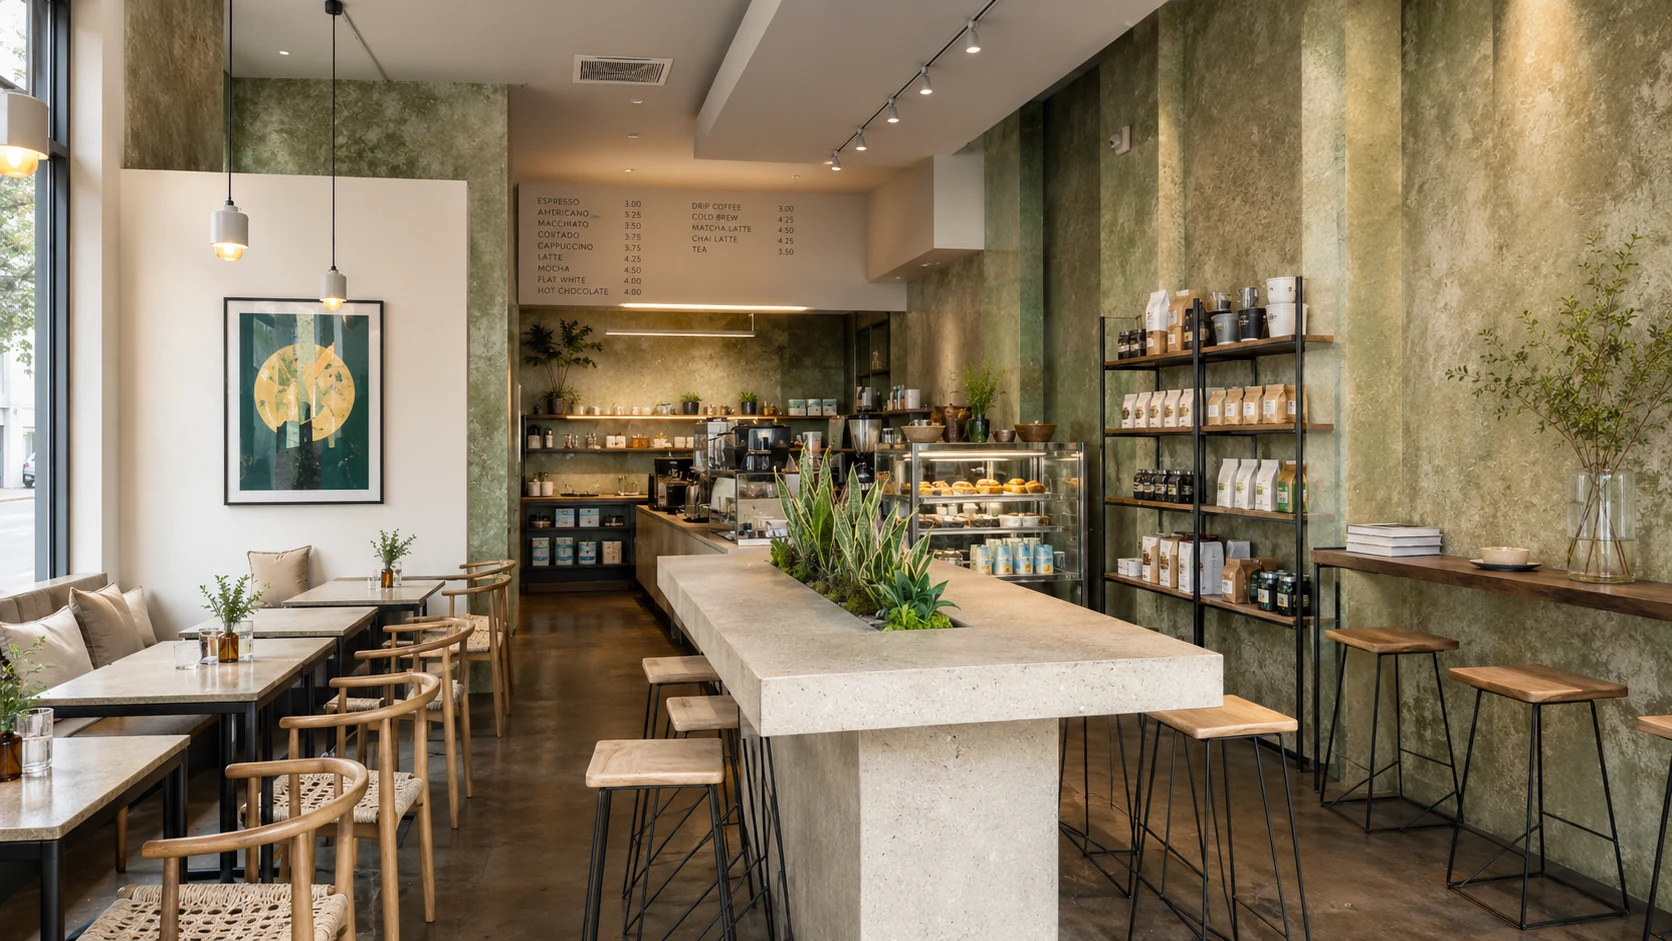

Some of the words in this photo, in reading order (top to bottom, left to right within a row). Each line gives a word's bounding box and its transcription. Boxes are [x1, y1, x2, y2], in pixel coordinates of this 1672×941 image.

[537, 197, 580, 206] ESPRESSO
[691, 202, 710, 210] DRIP
[712, 203, 741, 211] COFFEE
[537, 208, 590, 218] AMERICANO
[692, 213, 713, 221] COLD
[537, 220, 590, 228] MACCHIATO
[692, 224, 726, 232] MATCHA
[692, 234, 712, 243] CHAI
[714, 236, 738, 244] LATTE
[537, 242, 594, 251] CAPPUCCINO
[624, 244, 642, 252] 3.75
[692, 246, 708, 254] TEA
[538, 254, 563, 262] LATTE
[537, 264, 570, 272] MOCHA
[537, 276, 557, 284] FLAT
[560, 276, 586, 284] WHITE
[537, 286, 556, 294] HOT
[558, 287, 608, 296] CHOCOLATE
